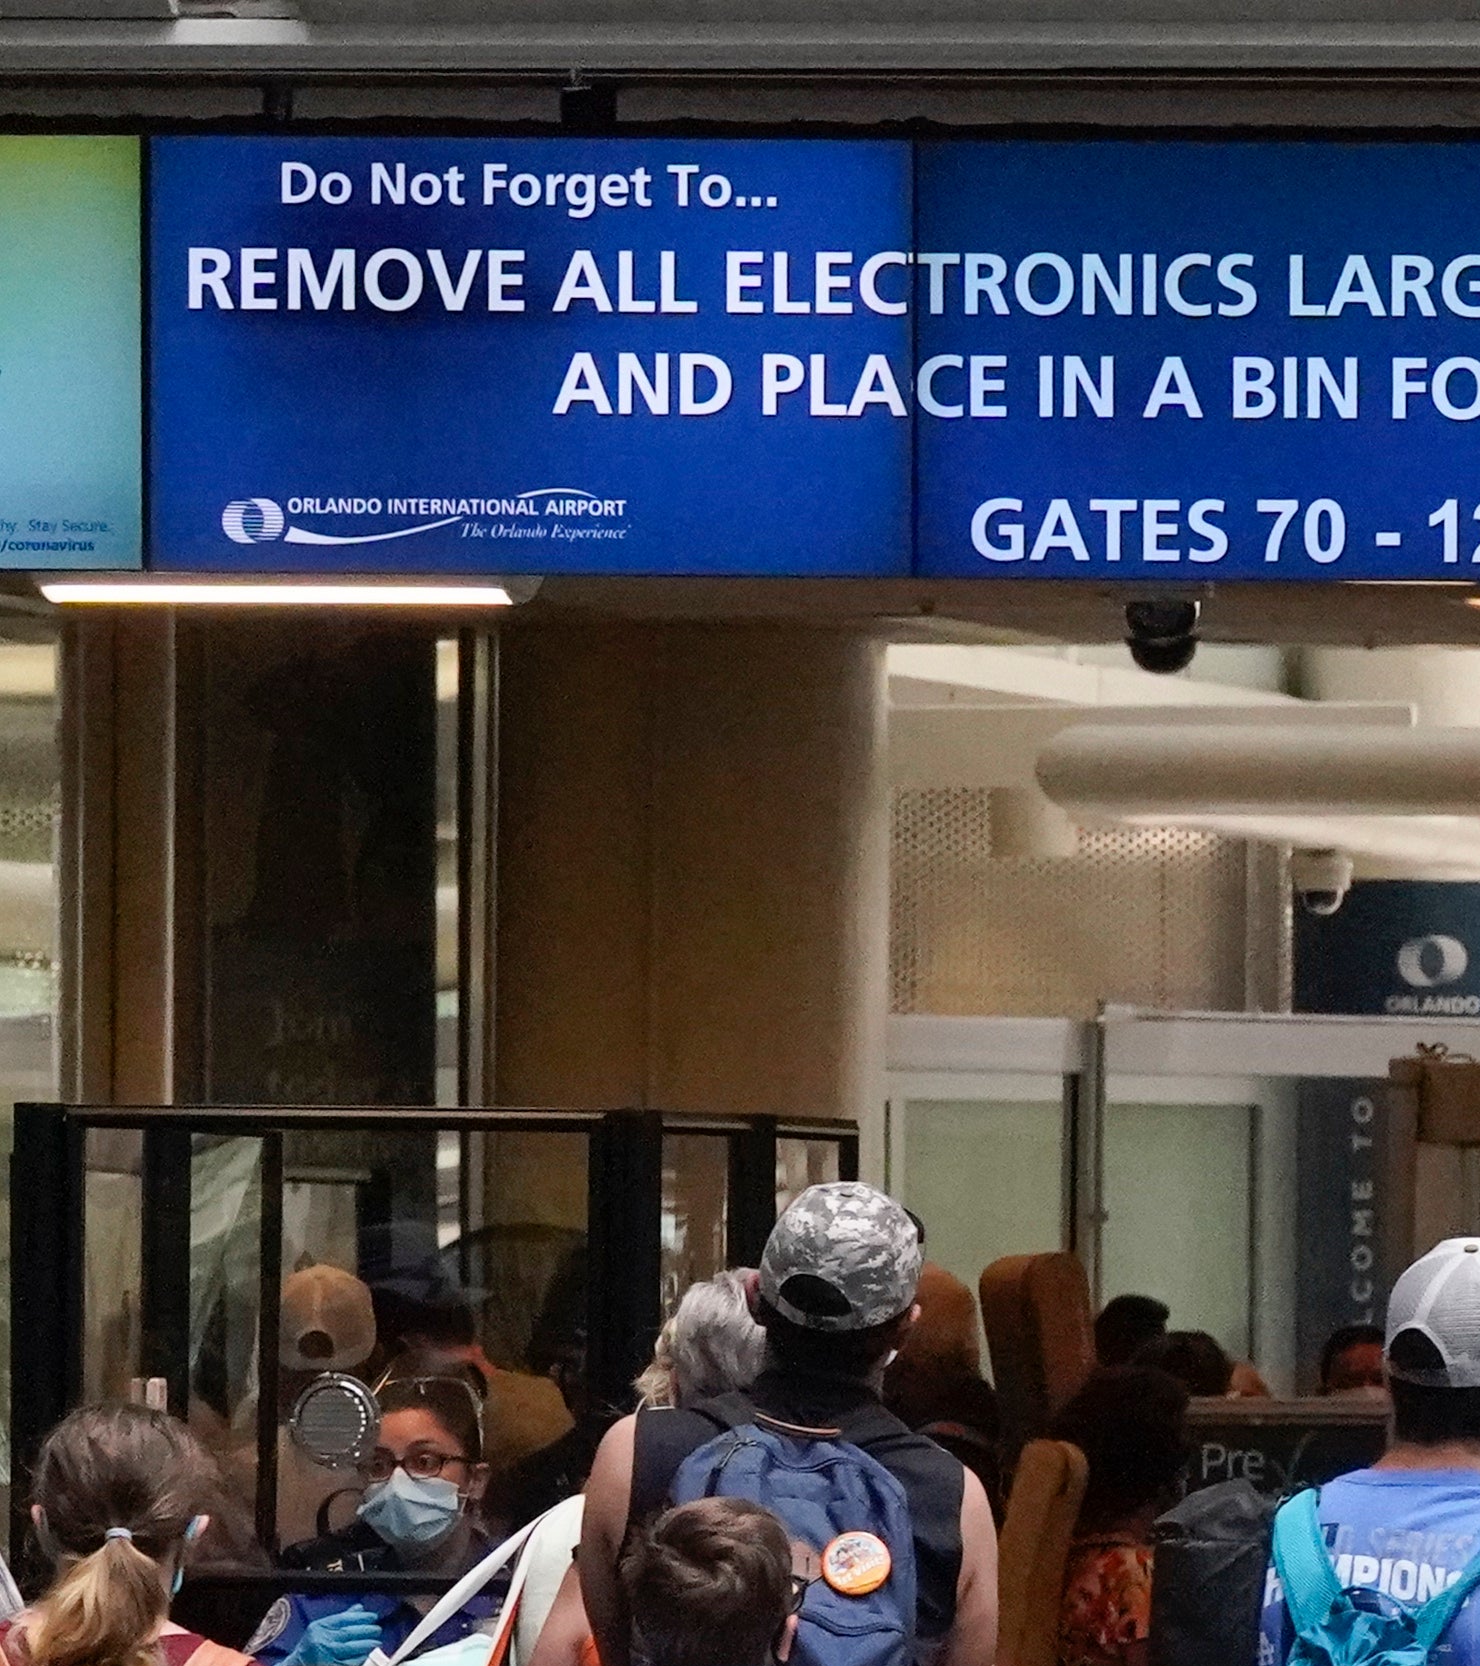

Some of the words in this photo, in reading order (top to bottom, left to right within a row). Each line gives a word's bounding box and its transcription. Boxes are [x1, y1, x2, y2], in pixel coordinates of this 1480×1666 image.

[282, 162, 351, 204] Do
[372, 163, 465, 205] Not
[484, 164, 651, 218] Forget
[667, 165, 776, 206] To...
[189, 248, 524, 311] REMOVE
[553, 250, 697, 312] ALL
[727, 251, 1256, 316] ELECTRONICS
[553, 353, 731, 414] AND
[763, 354, 1006, 417] PLACE
[1040, 356, 1113, 417] IN
[1143, 357, 1203, 417] A
[1233, 357, 1357, 418] BIN
[29, 519, 57, 534] Stay
[288, 497, 382, 514] ORLANDO
[387, 499, 539, 516] INTERNATIONAL
[544, 499, 627, 516] AIRPORT
[460, 521, 487, 538] The
[490, 522, 547, 539] Orlando
[551, 524, 631, 541] Experience
[971, 498, 1227, 562] GATES
[1257, 499, 1345, 562] 70
[1376, 533, 1400, 545] -
[1384, 995, 1480, 1014] ORLANDO
[1351, 1096, 1374, 1150] TO
[1202, 1442, 1266, 1481] Pre
